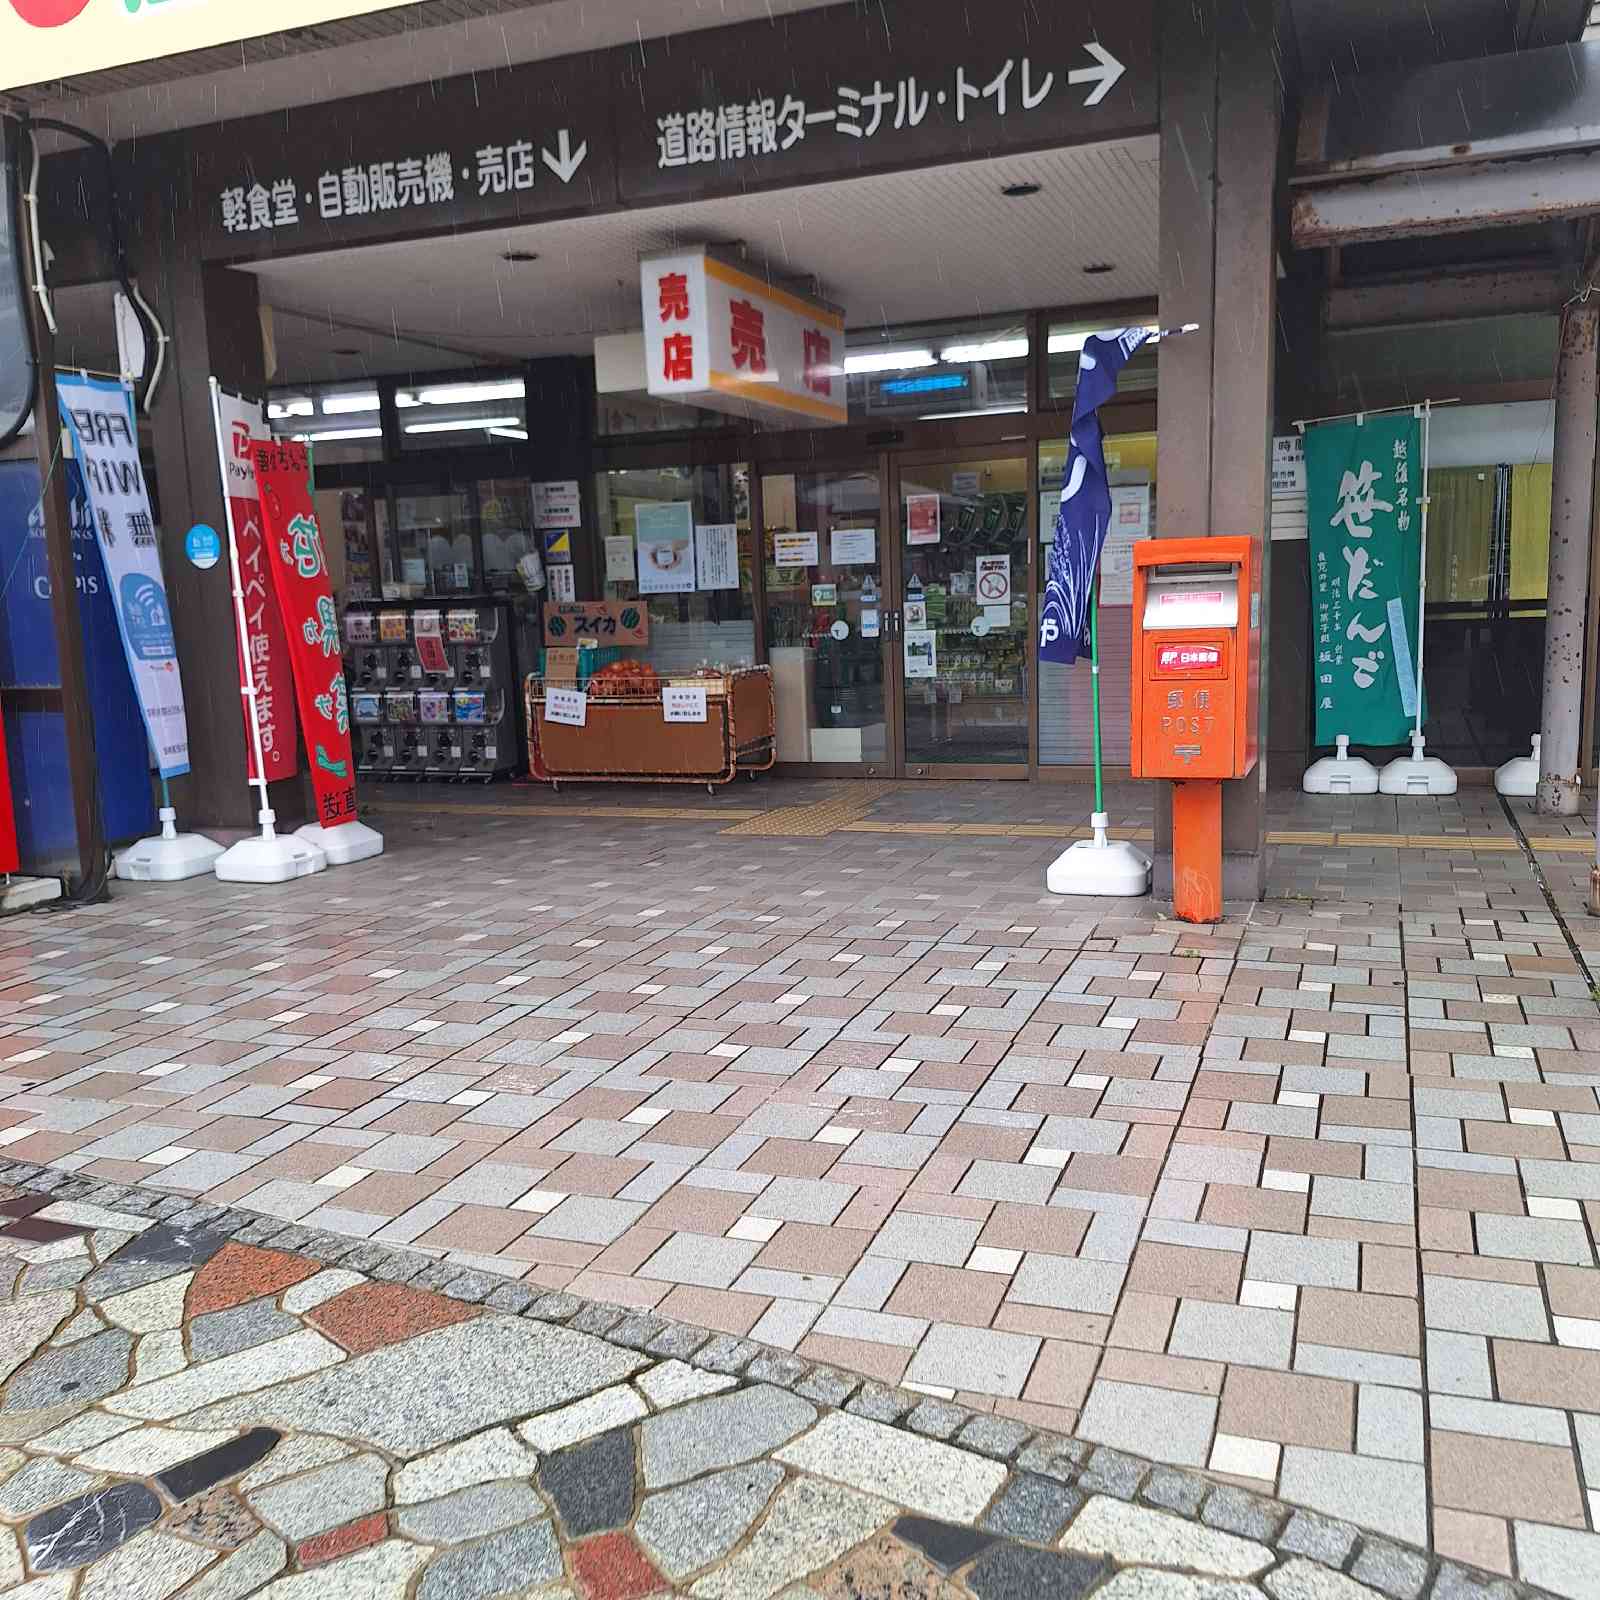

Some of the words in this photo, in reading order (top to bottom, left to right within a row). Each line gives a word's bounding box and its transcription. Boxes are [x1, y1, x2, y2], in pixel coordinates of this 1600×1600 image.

[658, 272, 694, 382] 売店
[729, 299, 832, 397] 売店
[1392, 439, 1411, 531] 越後名物
[1329, 460, 1395, 689] 笹だんご
[574, 614, 617, 636] スイカ
[1161, 715, 1217, 736] POST
[1167, 688, 1210, 710] 郵便
